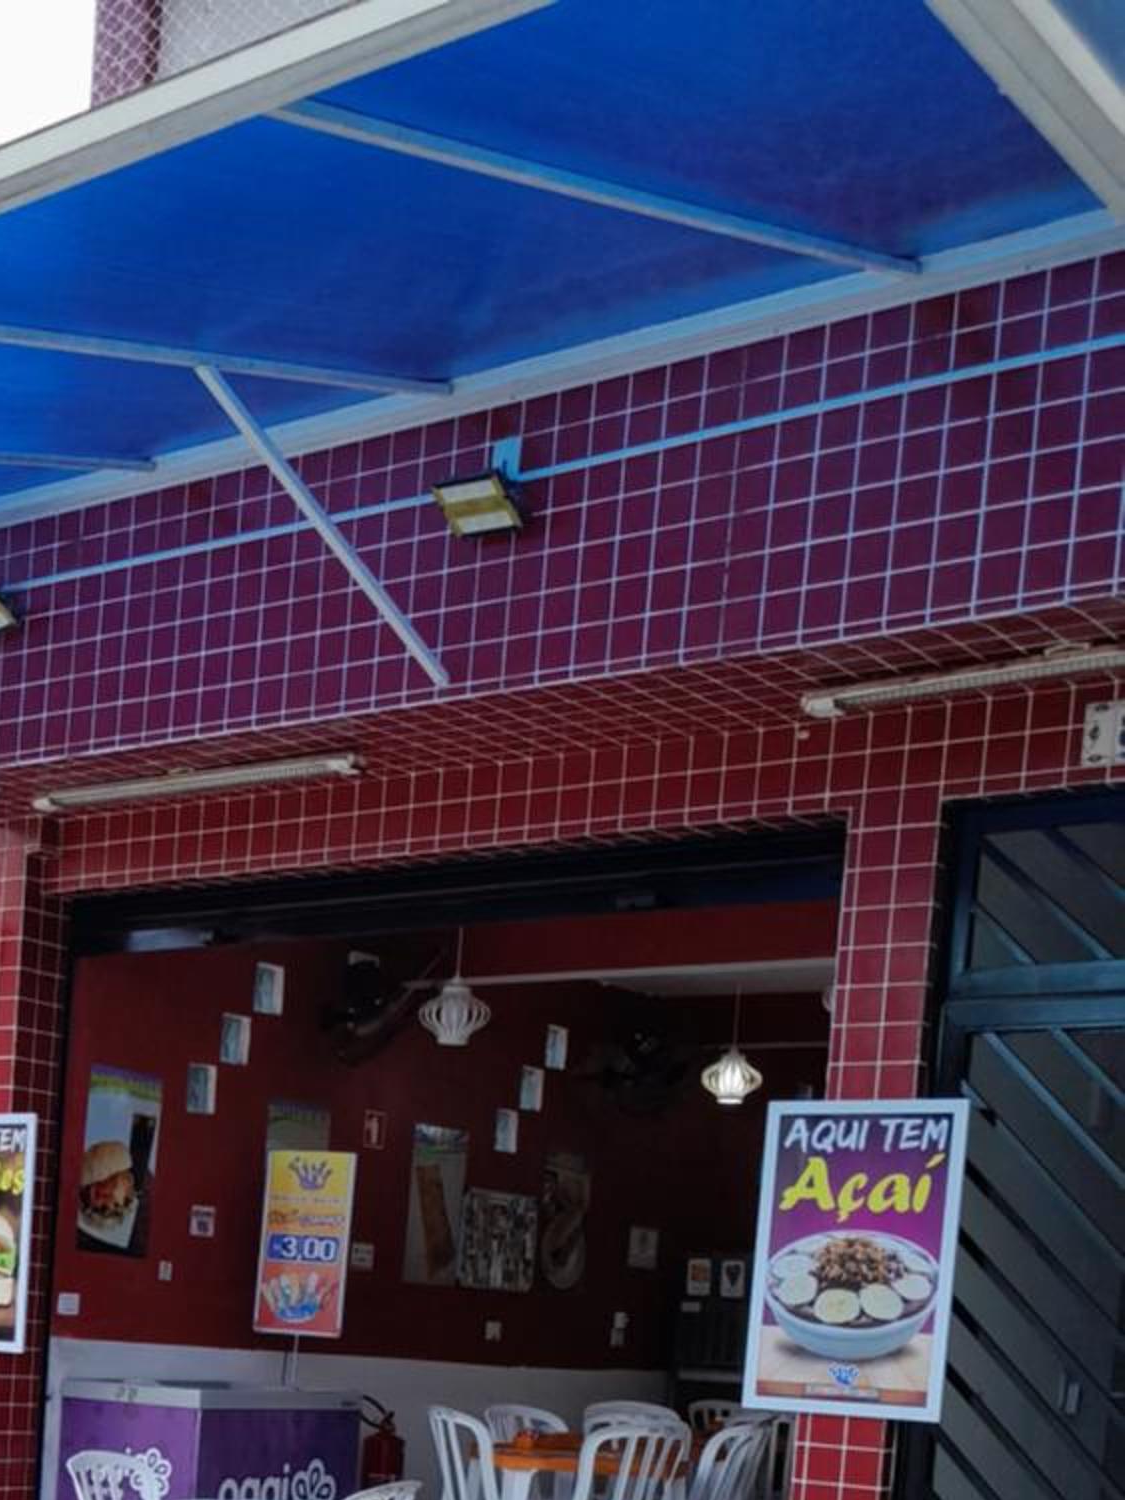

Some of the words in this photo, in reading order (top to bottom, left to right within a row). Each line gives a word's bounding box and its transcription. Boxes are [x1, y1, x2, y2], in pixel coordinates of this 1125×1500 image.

[784, 1118, 870, 1152] AQUI
[880, 1118, 949, 1151] TEM
[778, 1152, 946, 1223] Açaí
[282, 1236, 336, 1262] 3,00
